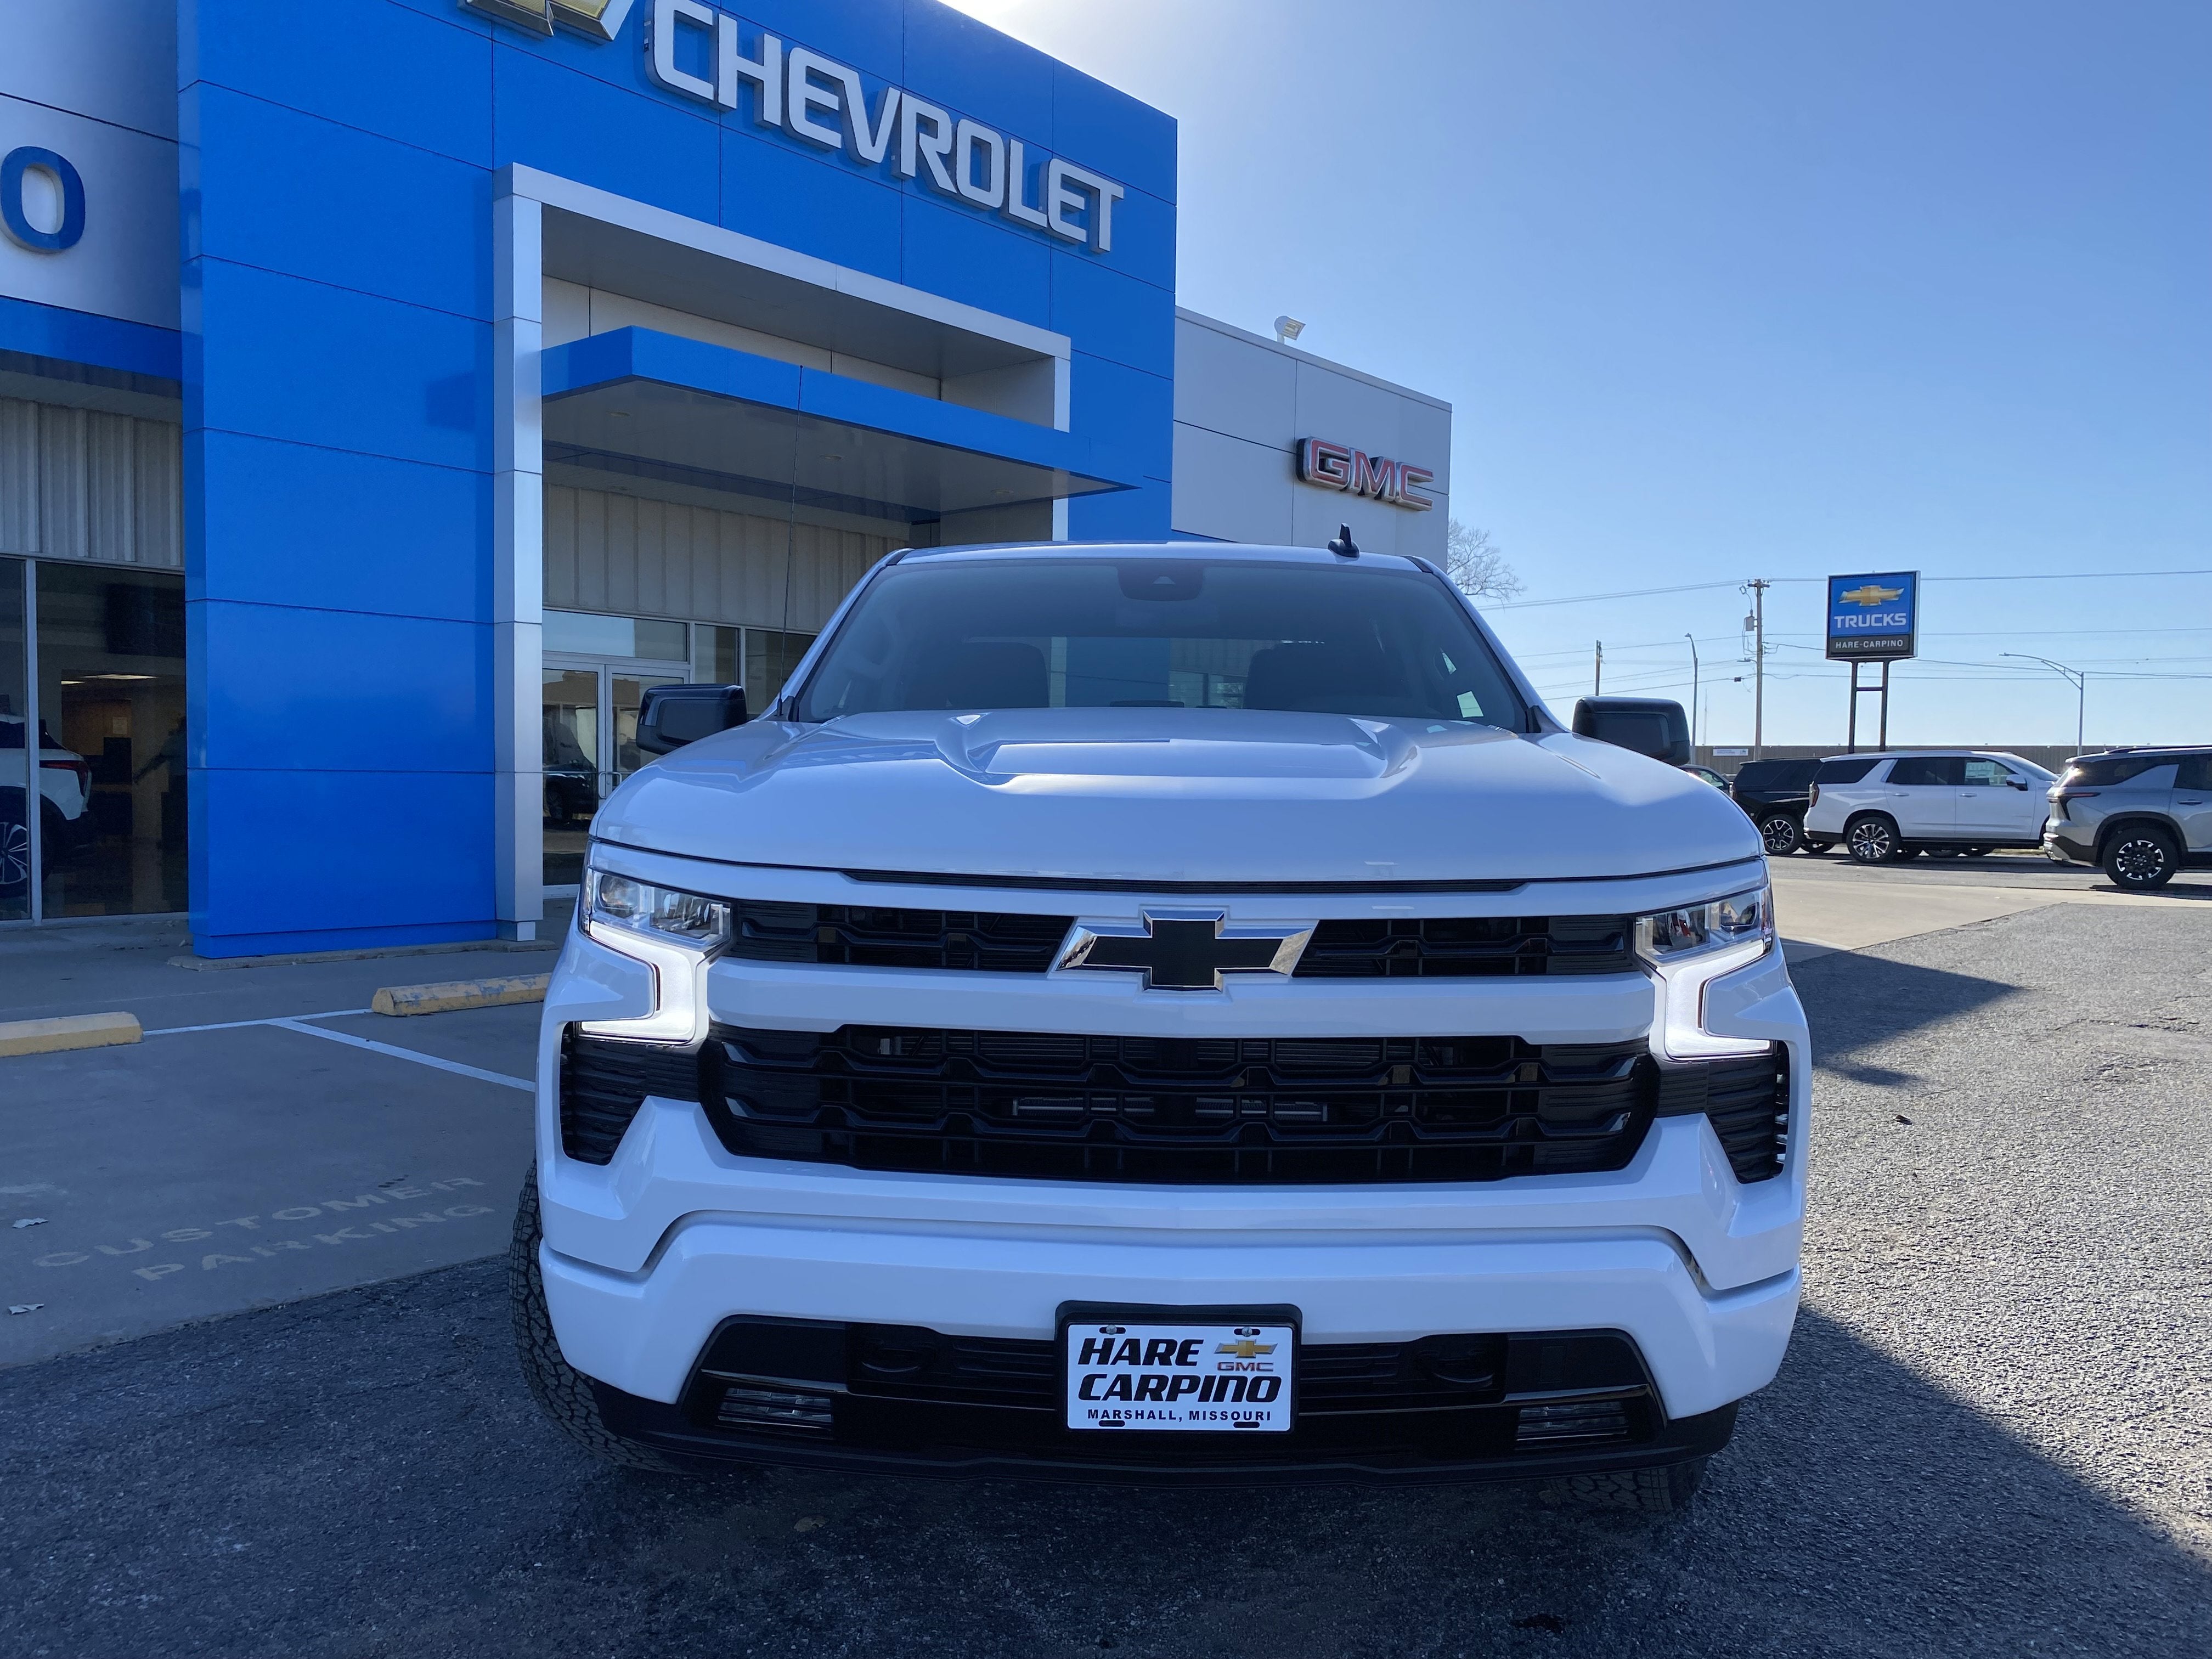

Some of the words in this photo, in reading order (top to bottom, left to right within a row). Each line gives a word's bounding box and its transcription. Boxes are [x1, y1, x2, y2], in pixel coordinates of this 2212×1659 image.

[646, 0, 1125, 253] CHEVROLET
[1299, 437, 1434, 511] GMC
[1834, 613, 1906, 628] TRUCKS
[1836, 639, 1903, 648] HARE-CARPINO
[32, 1177, 486, 1267] CUSTOMER
[131, 1205, 495, 1282] PARKING
[1077, 1338, 1204, 1367] HARE
[1216, 1362, 1274, 1372] GMC
[1077, 1374, 1282, 1403] CARPINO
[1087, 1409, 1183, 1423] MARSHALL,
[1189, 1410, 1271, 1421] MISSOURI
